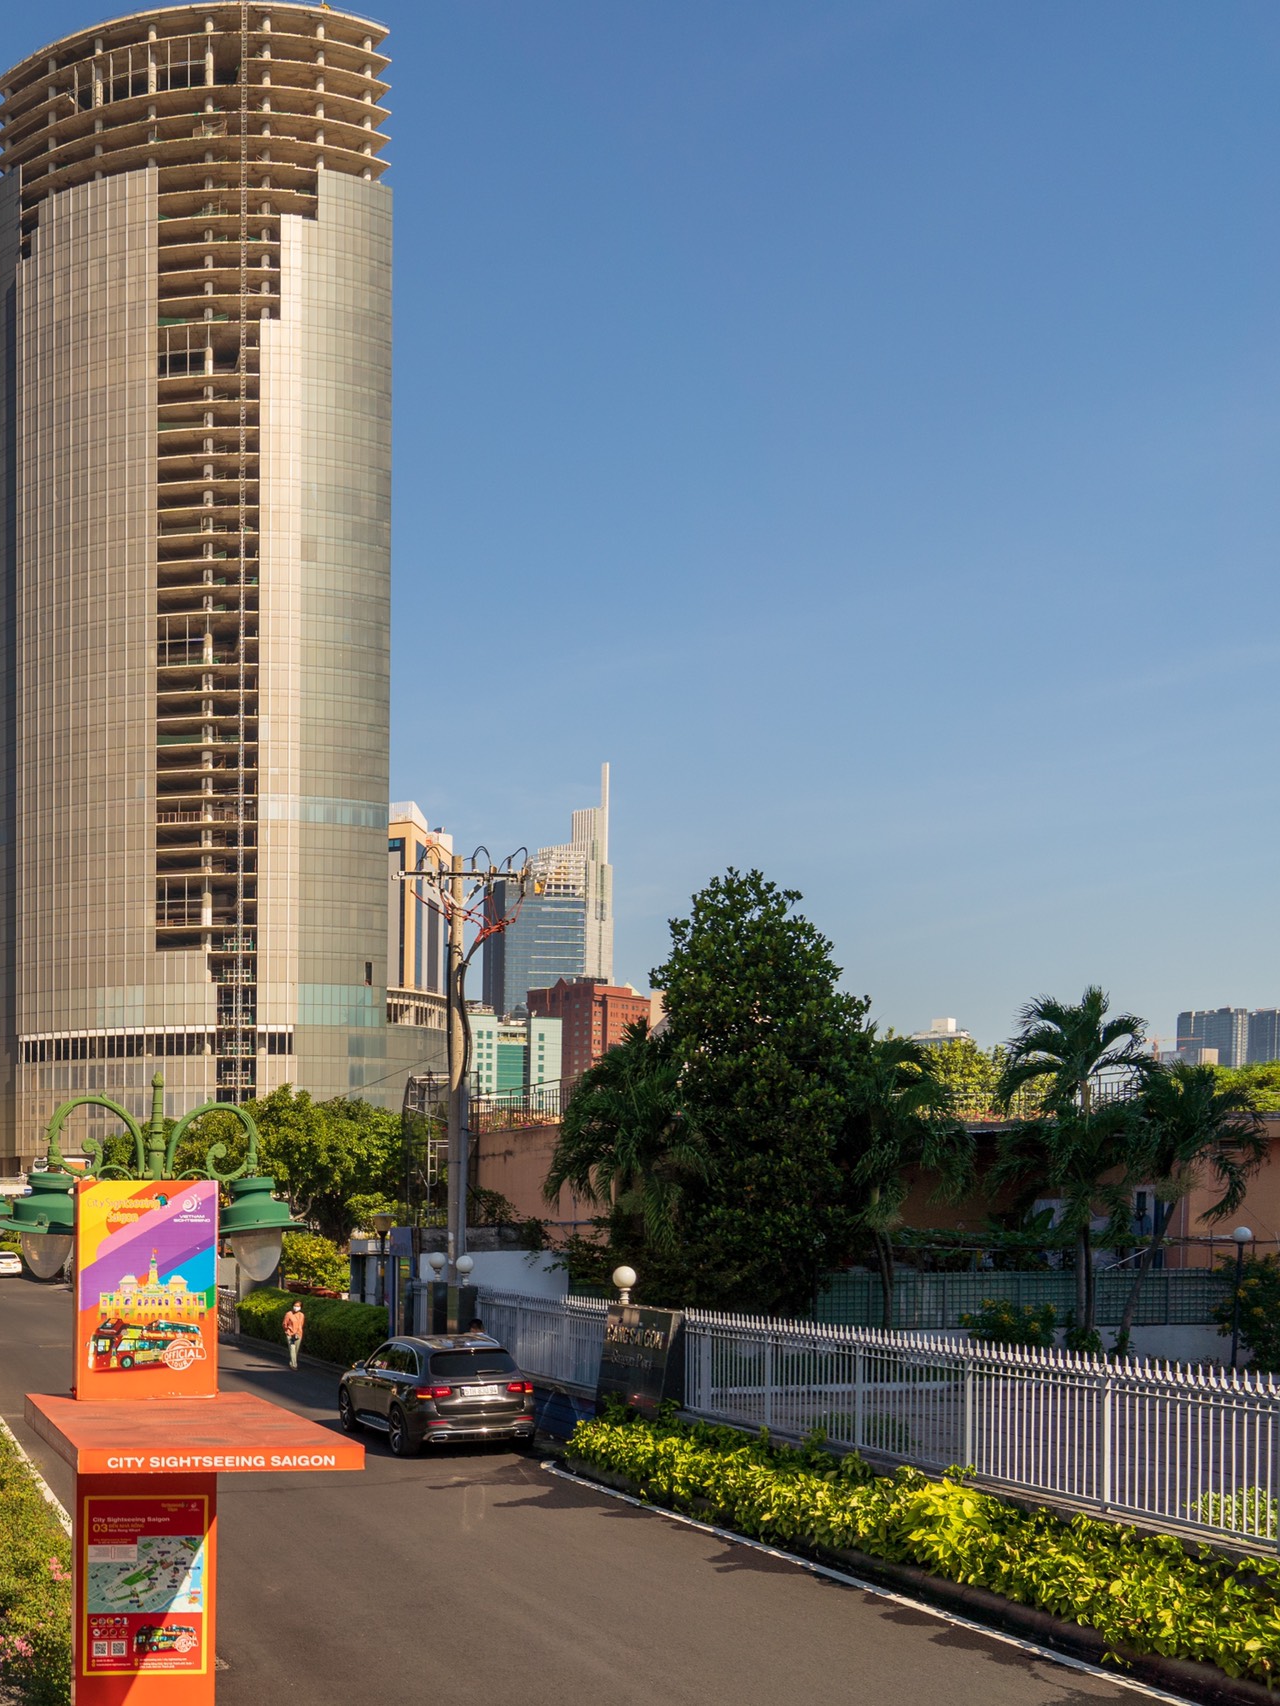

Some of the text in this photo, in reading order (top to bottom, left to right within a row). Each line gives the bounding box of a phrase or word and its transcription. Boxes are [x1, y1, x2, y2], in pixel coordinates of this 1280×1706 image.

[86, 1197, 160, 1211] City Sightseeing
[107, 1211, 139, 1224] Saigon
[164, 1349, 201, 1360] OFFICIAL
[107, 1455, 335, 1469] CITY SIGHTSEEING SAIGON
[92, 1523, 108, 1533] 03
